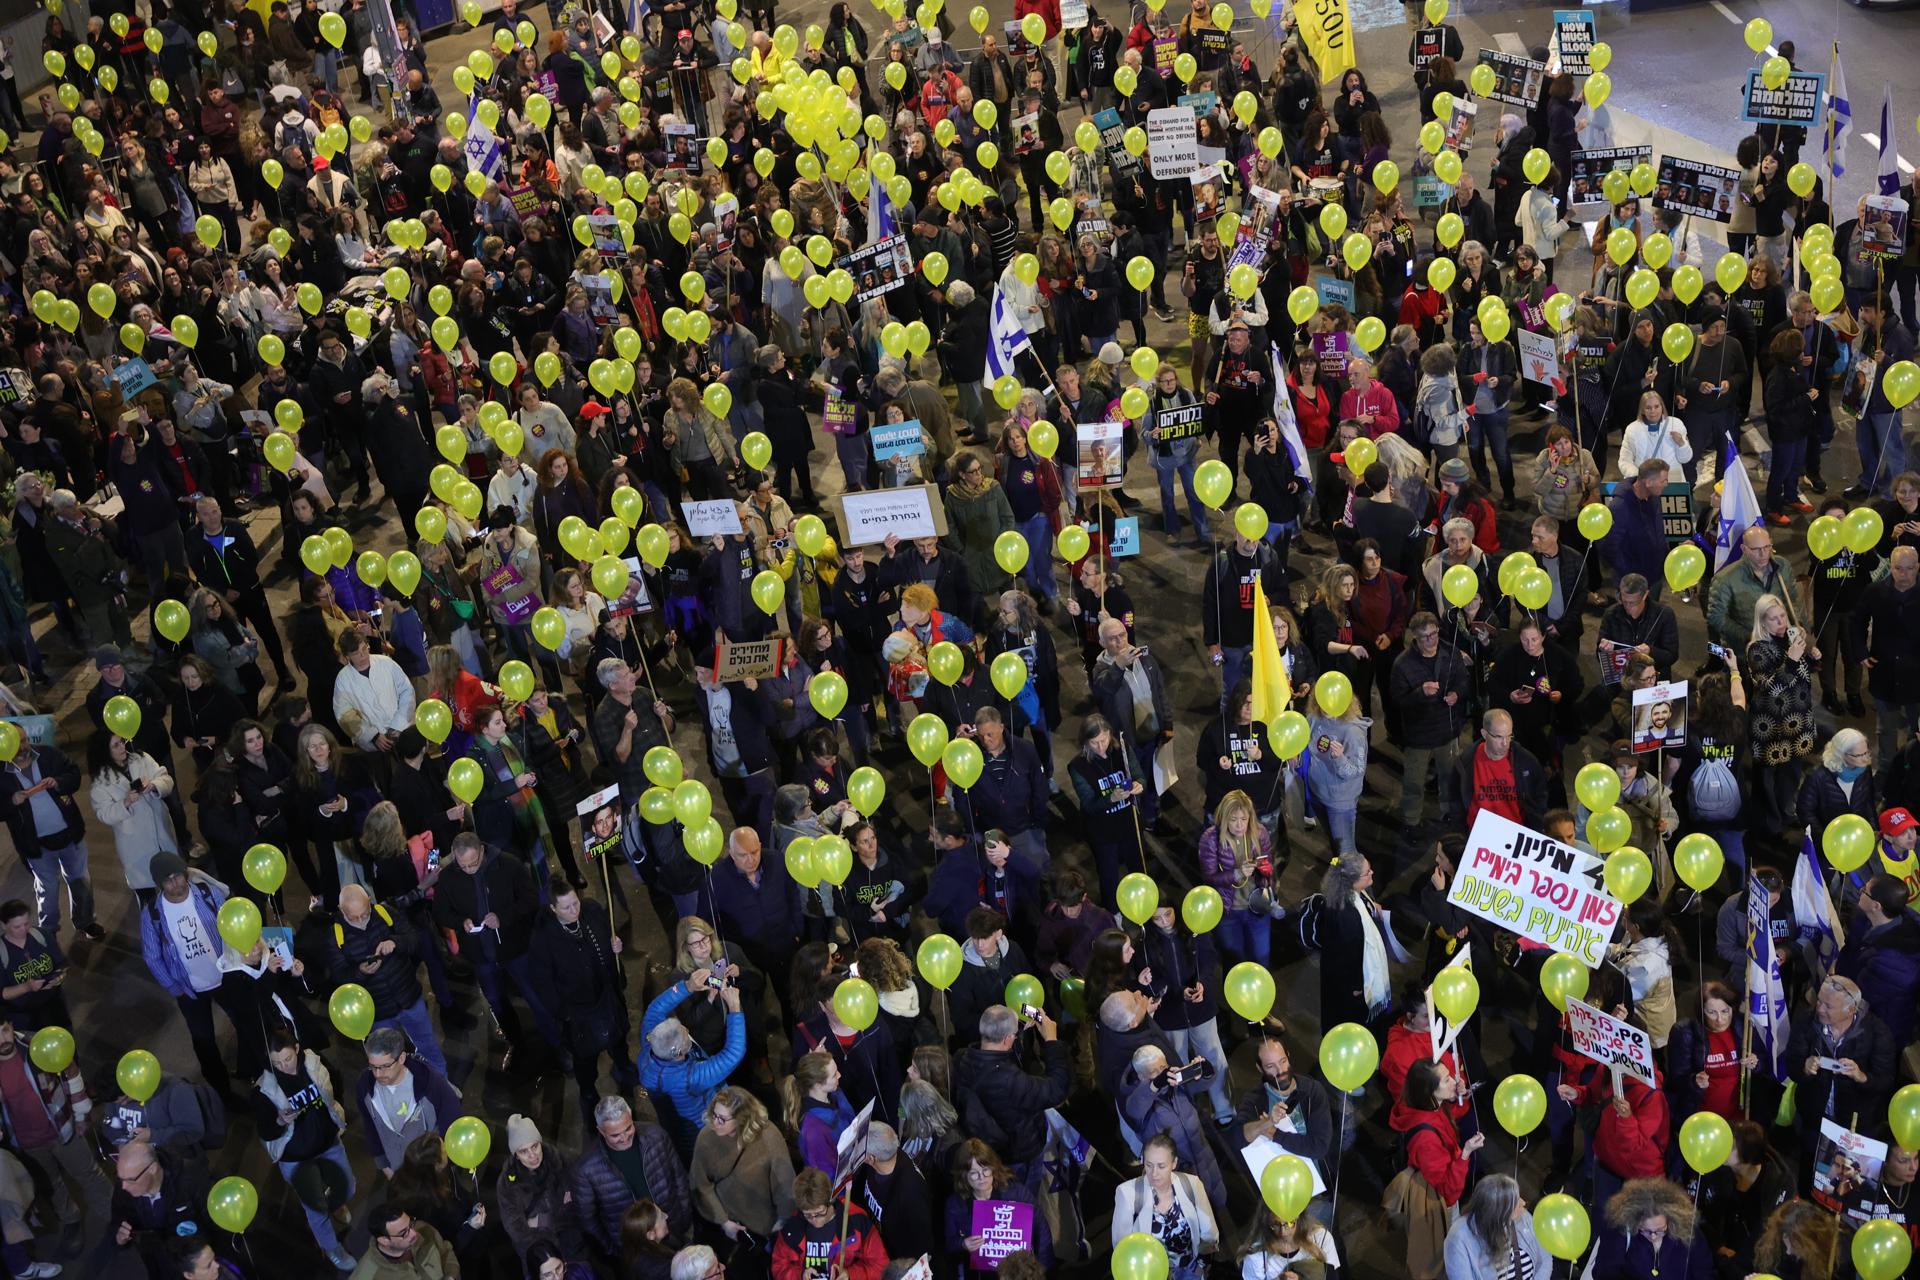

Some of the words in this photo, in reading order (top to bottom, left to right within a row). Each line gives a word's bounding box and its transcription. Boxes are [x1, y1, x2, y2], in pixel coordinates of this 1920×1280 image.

[1563, 22, 1585, 32] HOW
[1424, 34, 1436, 44] עם
[1561, 32, 1590, 42] MUCH
[1562, 43, 1592, 52] BLOOD
[1493, 52, 1510, 63] כולם
[1562, 55, 1582, 65] WILL
[1527, 60, 1544, 71] כולם
[1564, 65, 1593, 75] SPILLED
[1752, 89, 1816, 107] המלחמה
[1763, 106, 1787, 116] כולנו
[1788, 107, 1813, 119] למען
[1153, 154, 1174, 163] ONLY
[1175, 152, 1196, 161] MORE
[1585, 149, 1616, 159] בהסכם
[1616, 147, 1635, 157] כולם
[1675, 158, 1704, 171] בהסכם
[1705, 164, 1725, 174] כולם
[1155, 167, 1196, 177] DEFENDERS
[876, 239, 895, 252] כולם
[855, 247, 881, 262] בהסכם
[1160, 407, 1203, 428] בלעדיהם
[710, 505, 732, 514] 43.2
[1120, 526, 1131, 538] לא
[1120, 537, 1128, 545] עד
[1826, 566, 1856, 579] HOME!
[730, 644, 770, 656] מחזירים
[729, 655, 752, 665] כולם
[753, 654, 769, 663] את
[1615, 653, 1627, 666] 5
[1504, 832, 1576, 874] מיליון.
[1472, 847, 1523, 886] בימים
[1529, 869, 1579, 912] נספר
[1453, 874, 1524, 923] בשניות
[1577, 893, 1616, 926] זמן
[1526, 906, 1603, 963] גיהינום
[185, 941, 204, 951] THE
[185, 947, 211, 960] WAR.
[1598, 1015, 1613, 1033] כל
[1615, 1027, 1644, 1049] שם.
[1628, 1044, 1644, 1060] כל
[984, 1230, 1021, 1239] החטוף
[806, 1241, 819, 1257] הם
